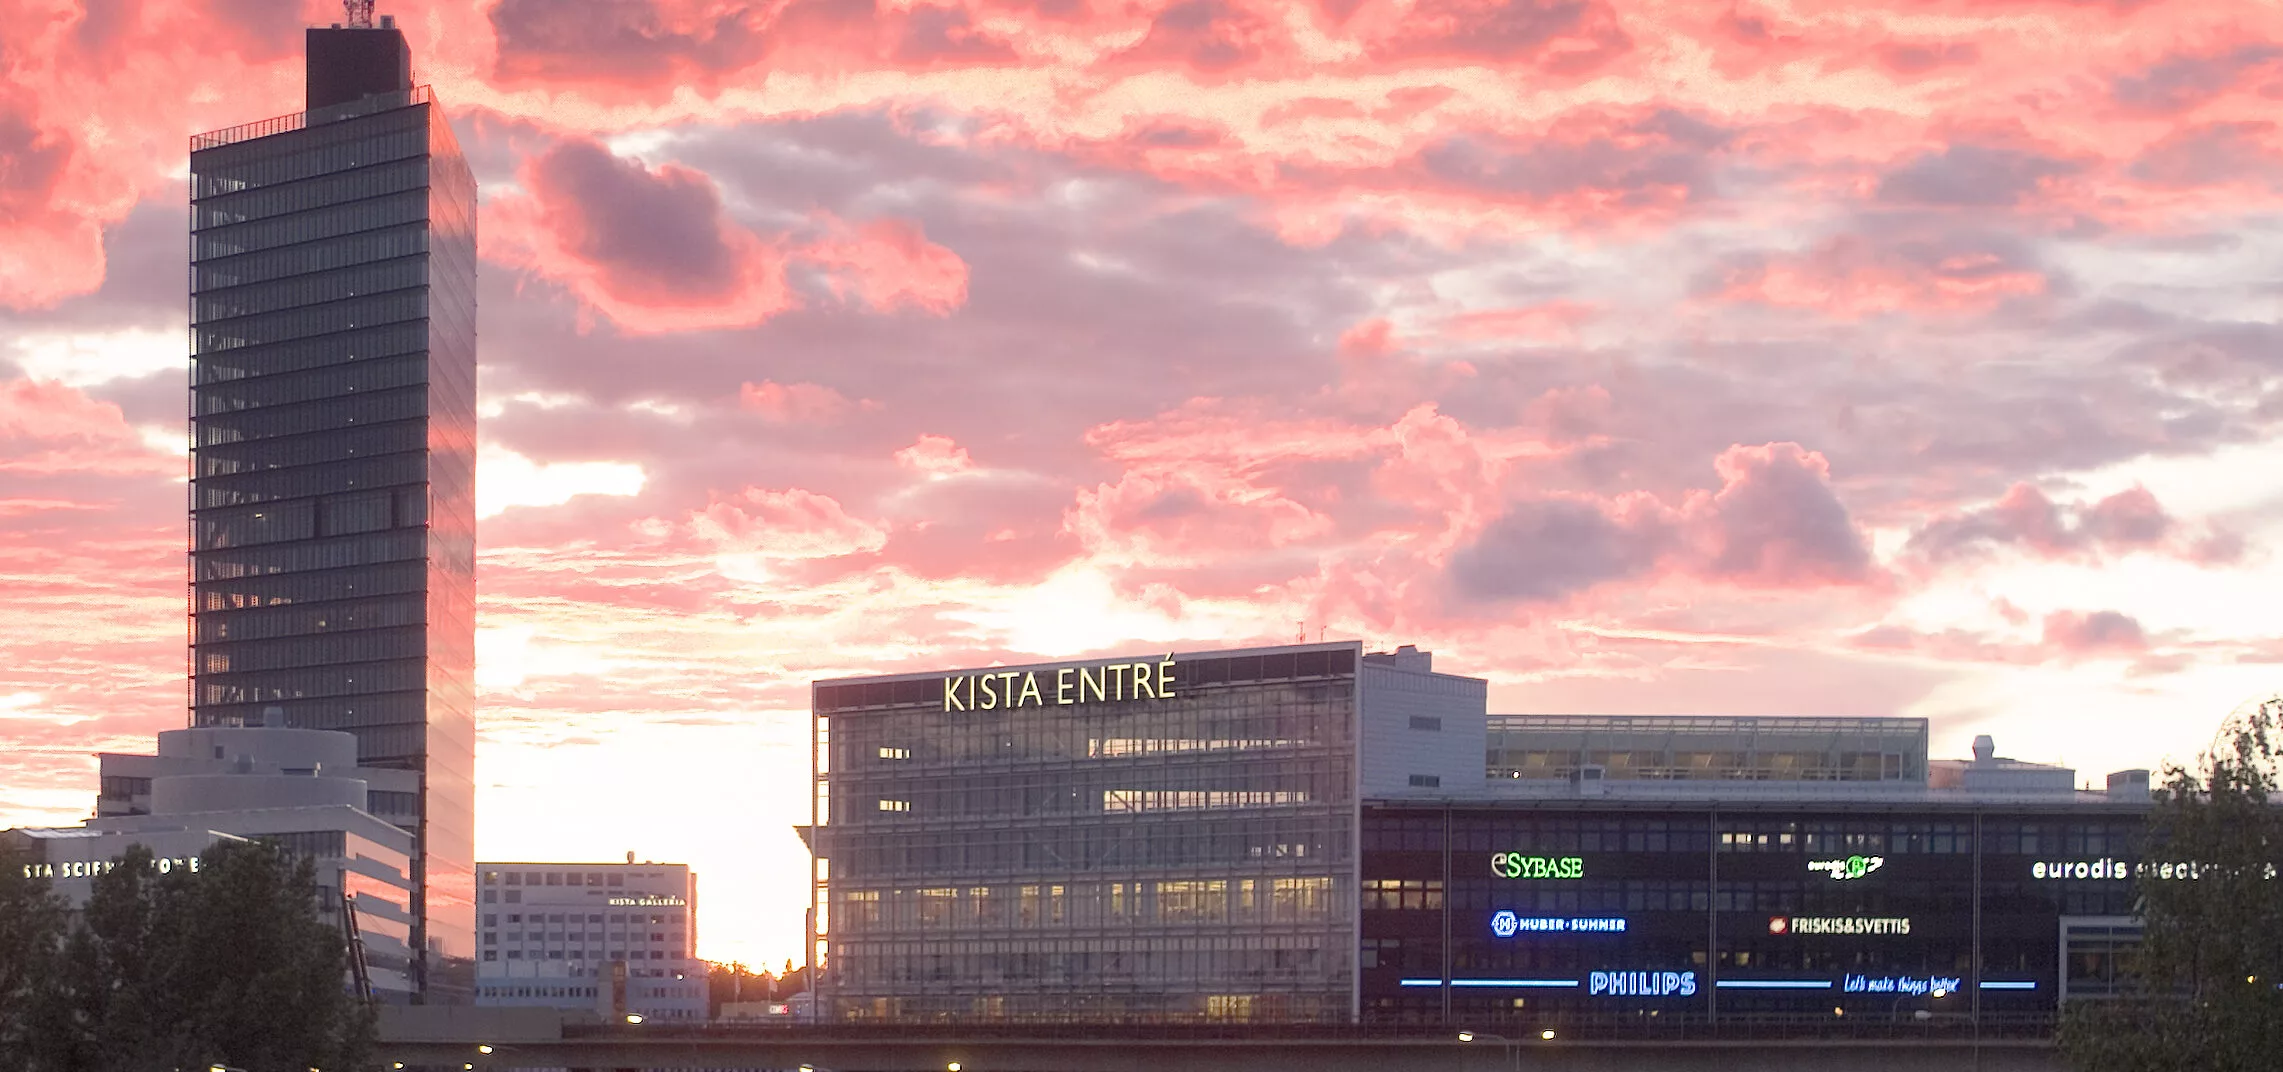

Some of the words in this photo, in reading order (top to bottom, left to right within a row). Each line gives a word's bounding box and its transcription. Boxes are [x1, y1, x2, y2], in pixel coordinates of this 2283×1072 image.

[944, 671, 1043, 712] KISTA
[1057, 652, 1176, 705] ENTRÉ
[2032, 858, 2128, 879] eurodis
[1791, 917, 1910, 935] FRISKIS&SVETTIS
[1590, 971, 1696, 996] PHILIPS
